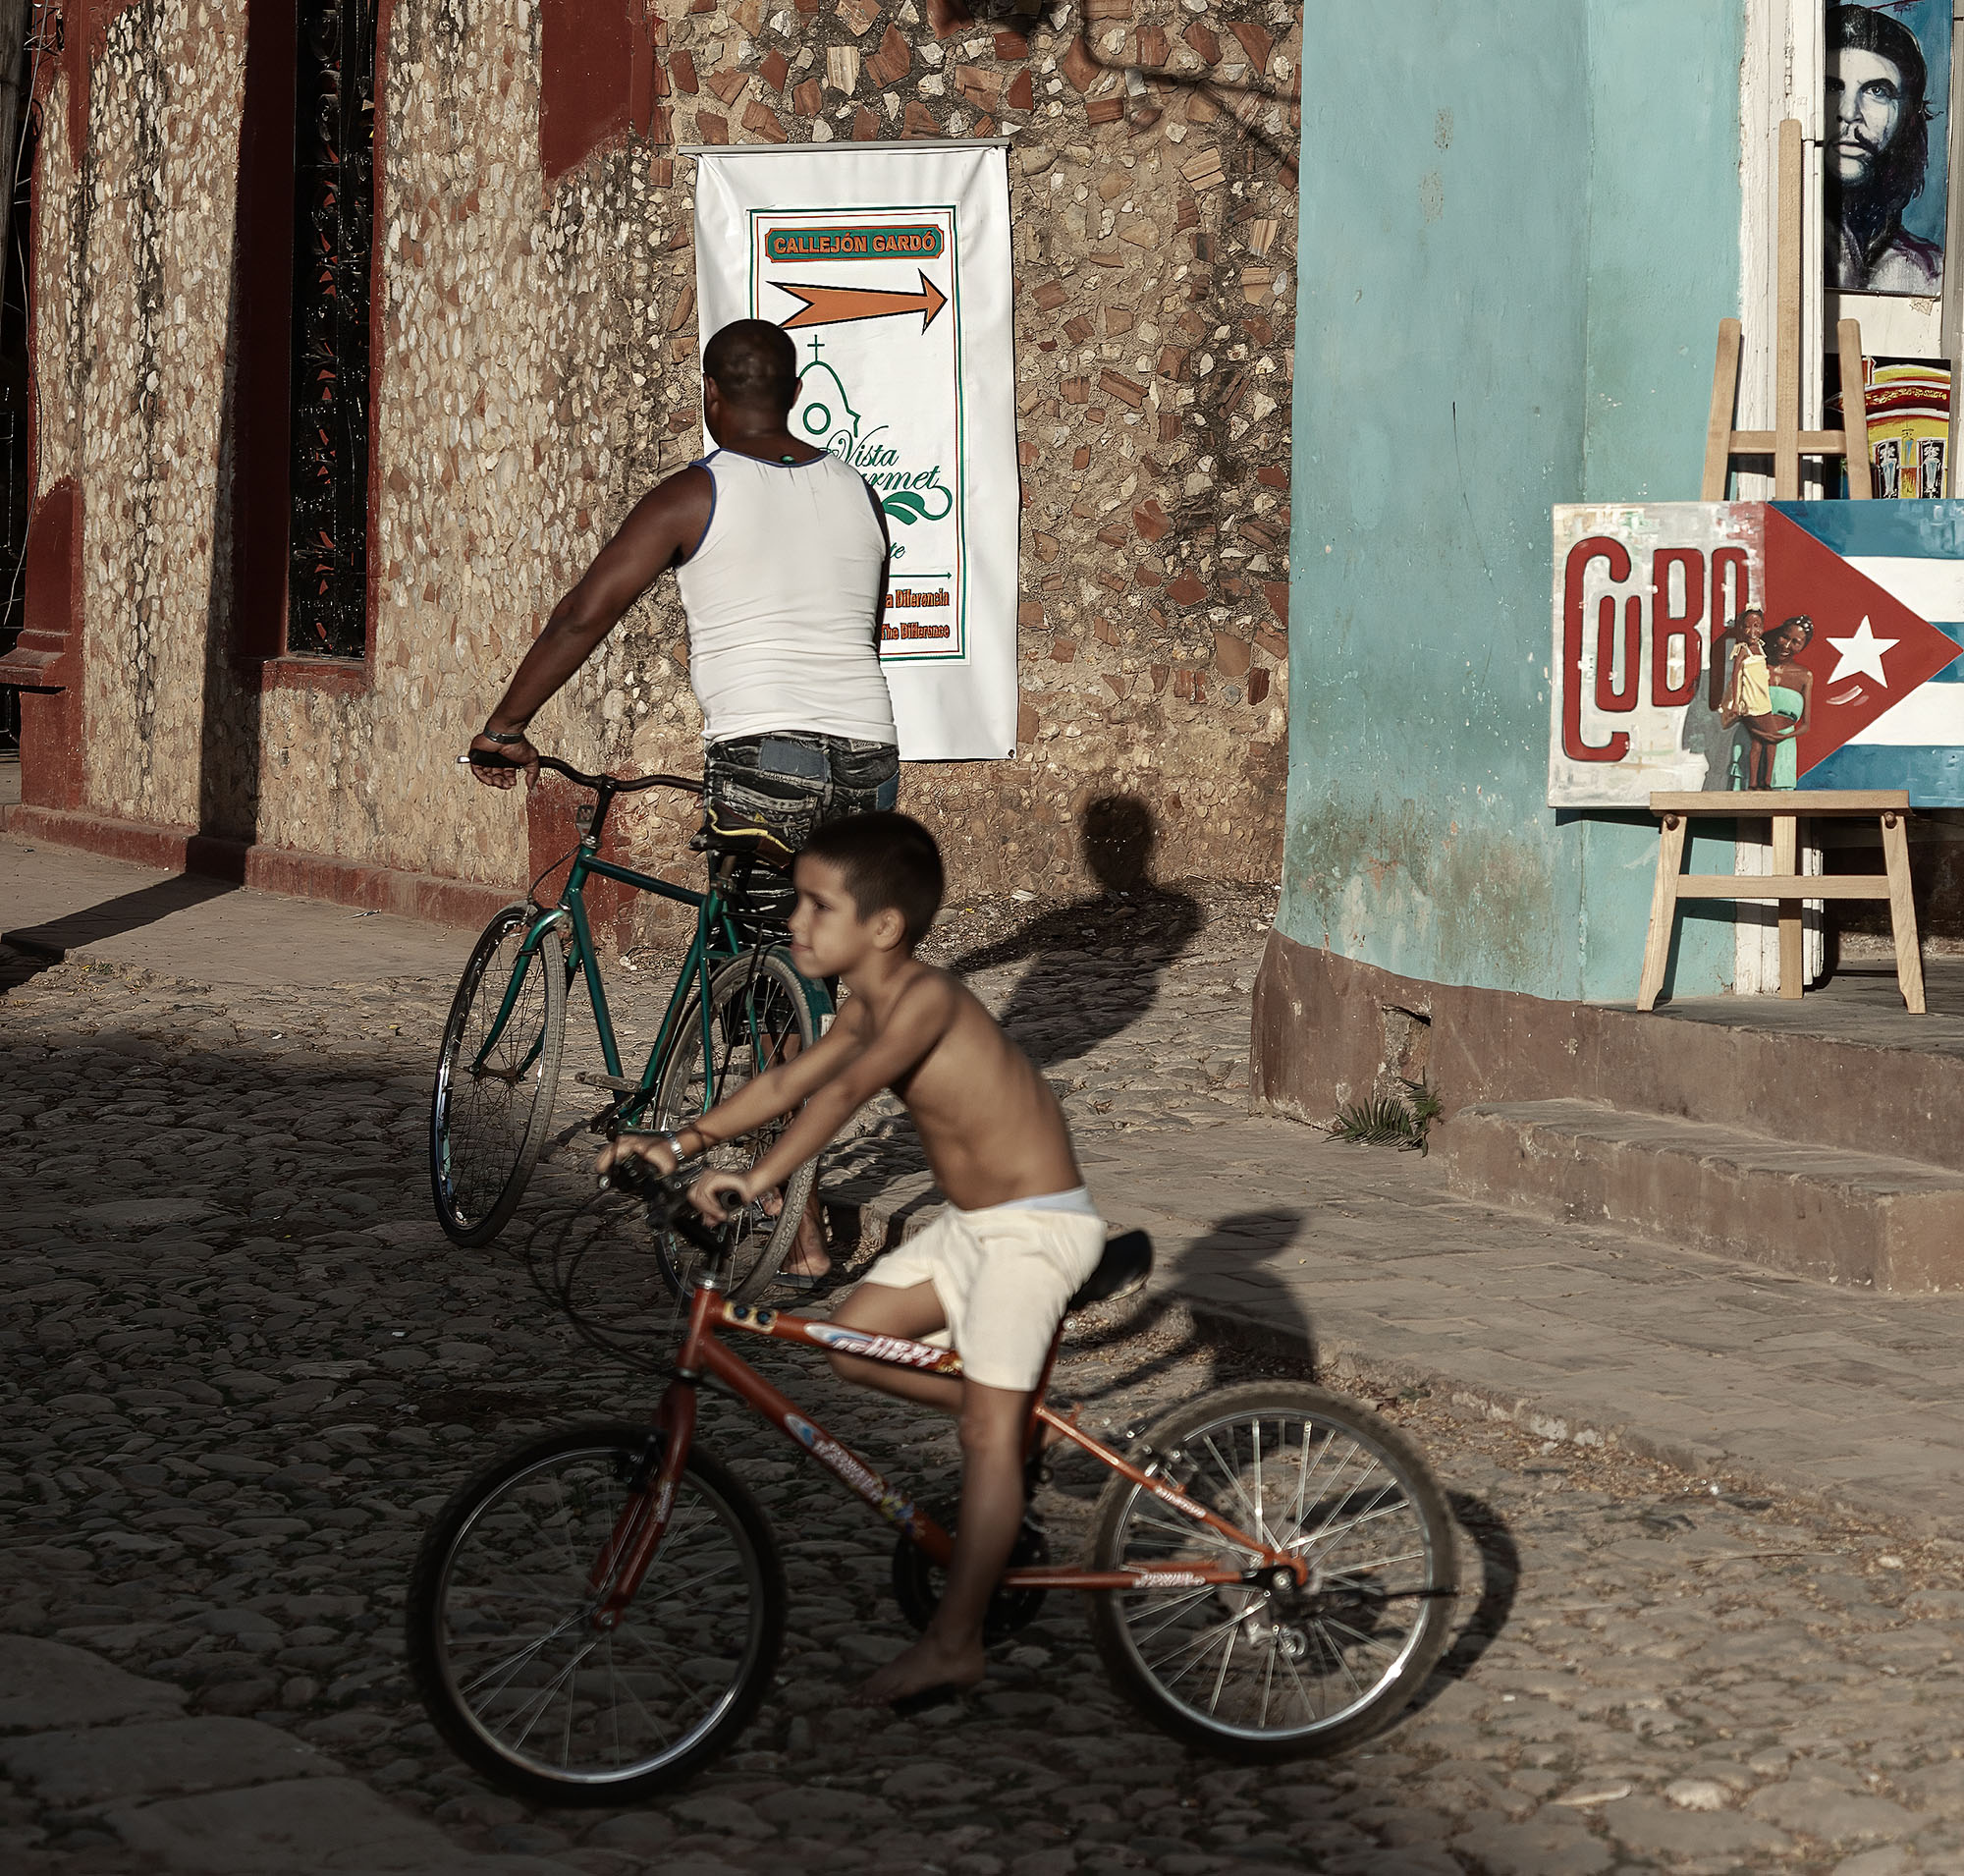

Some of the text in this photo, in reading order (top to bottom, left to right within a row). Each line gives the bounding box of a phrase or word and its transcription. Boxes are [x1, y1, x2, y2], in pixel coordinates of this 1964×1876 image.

[774, 230, 936, 254] CALLEJÓN GARDÓ
[826, 425, 900, 468] Vista
[895, 587, 950, 608] Diferencia
